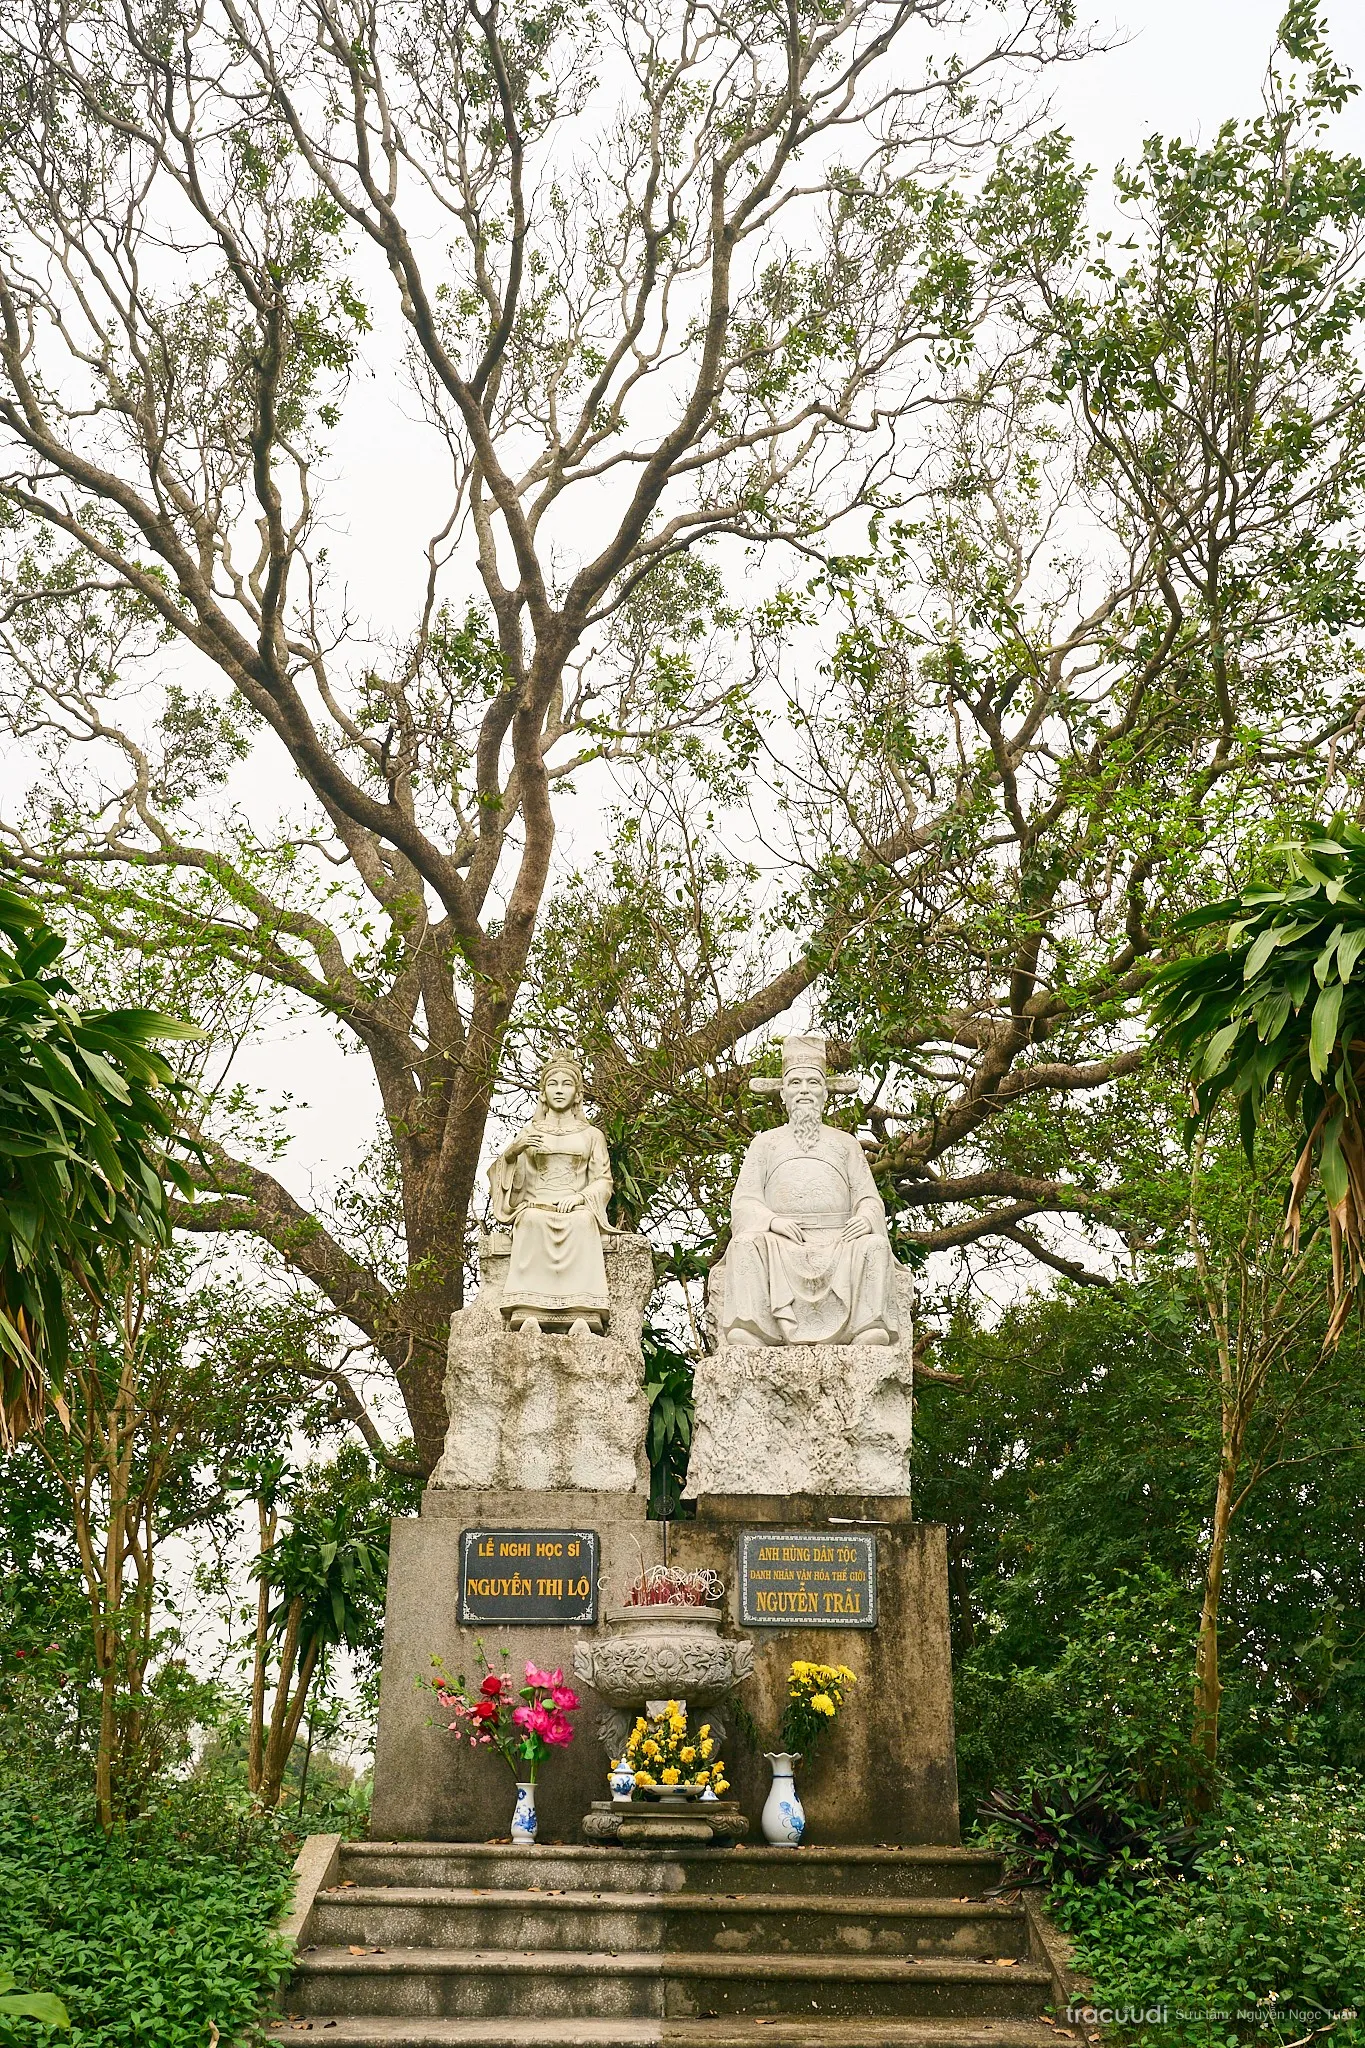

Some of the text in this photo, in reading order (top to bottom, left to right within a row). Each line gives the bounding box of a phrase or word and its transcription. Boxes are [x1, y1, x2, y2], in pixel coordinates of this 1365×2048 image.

[478, 1537, 580, 1560] LỄ NGHI HỌC SĨ
[758, 1544, 857, 1565] ANH HÙNG DÂN TỘC
[750, 1570, 770, 1580] DANH
[773, 1568, 794, 1580] NHÂN
[814, 1568, 830, 1581] HÓA
[832, 1567, 847, 1581] THẾ
[467, 1572, 589, 1600] NGUYỄN THỊ LỘ
[756, 1582, 861, 1614] NGUYỄN TRÃI
